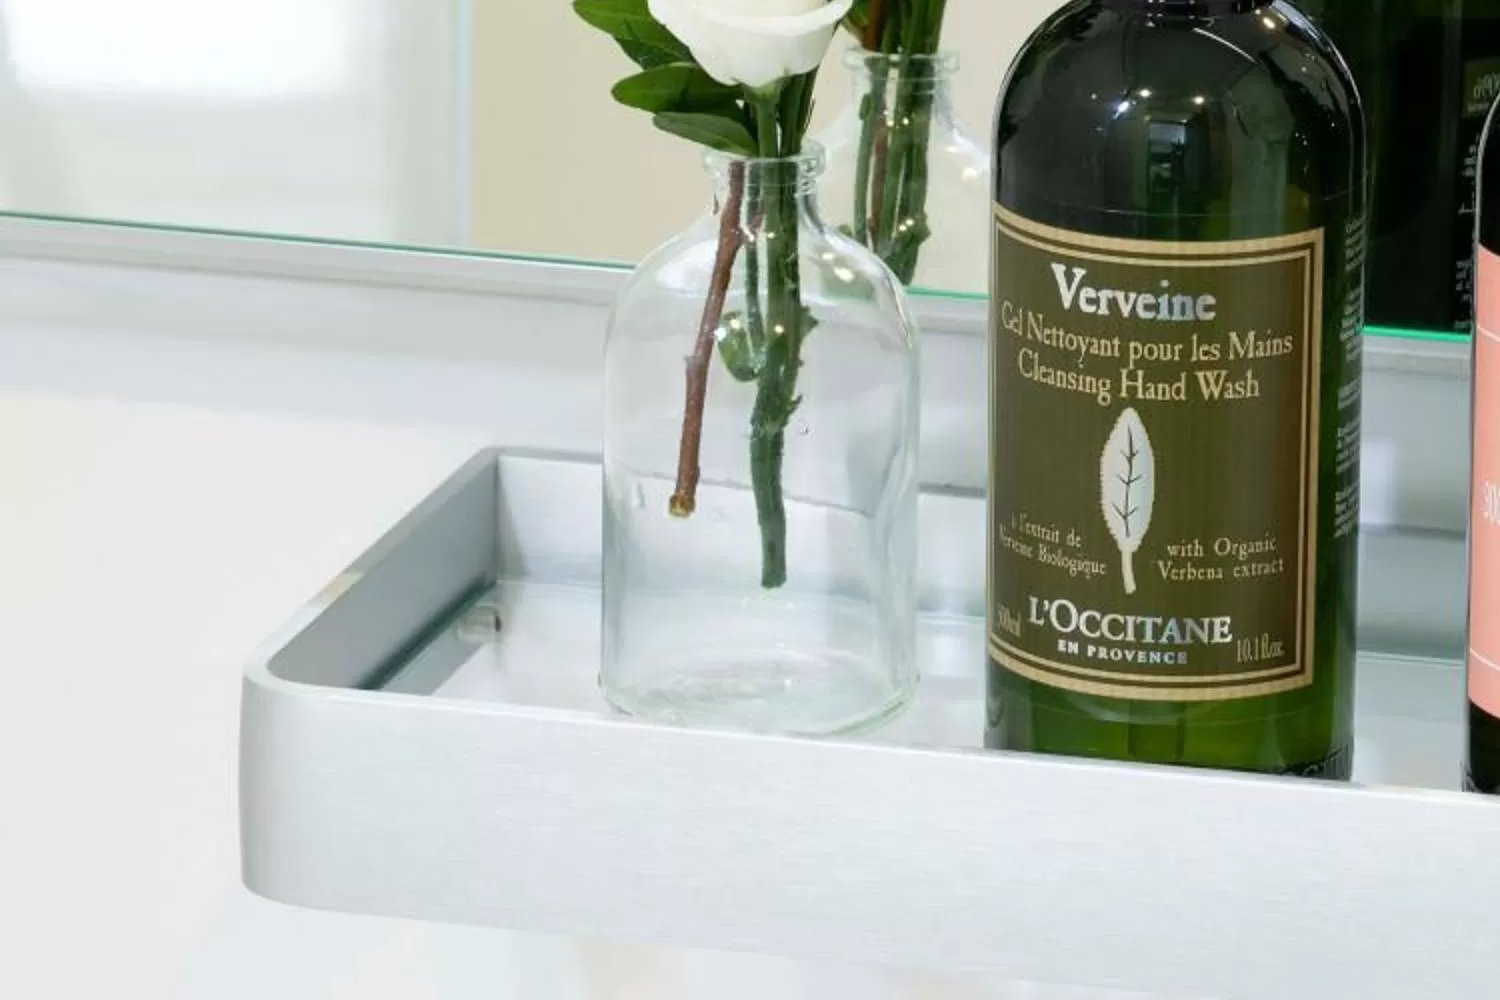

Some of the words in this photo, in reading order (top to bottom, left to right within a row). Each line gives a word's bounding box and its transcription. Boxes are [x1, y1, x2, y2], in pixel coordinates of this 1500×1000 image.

[1050, 262, 1217, 321] Verveine
[1001, 299, 1023, 336] Gel
[1027, 315, 1121, 368] Nettoyant
[1129, 340, 1184, 370] pour
[1191, 333, 1221, 362] les
[1228, 327, 1294, 362] Mains
[1018, 348, 1112, 407] Cleansing
[1120, 367, 1187, 401] Hand
[1196, 368, 1261, 400] Wash
[1067, 527, 1083, 548] de
[1167, 539, 1204, 559] with
[1213, 531, 1278, 561] Organic
[1038, 543, 1107, 579] Biologique
[1157, 559, 1223, 581] Verbena
[1233, 558, 1285, 579] extract
[1027, 594, 1233, 645] L'OCCITANE
[1057, 640, 1079, 654] EN
[1087, 643, 1188, 665] PROVENCE
